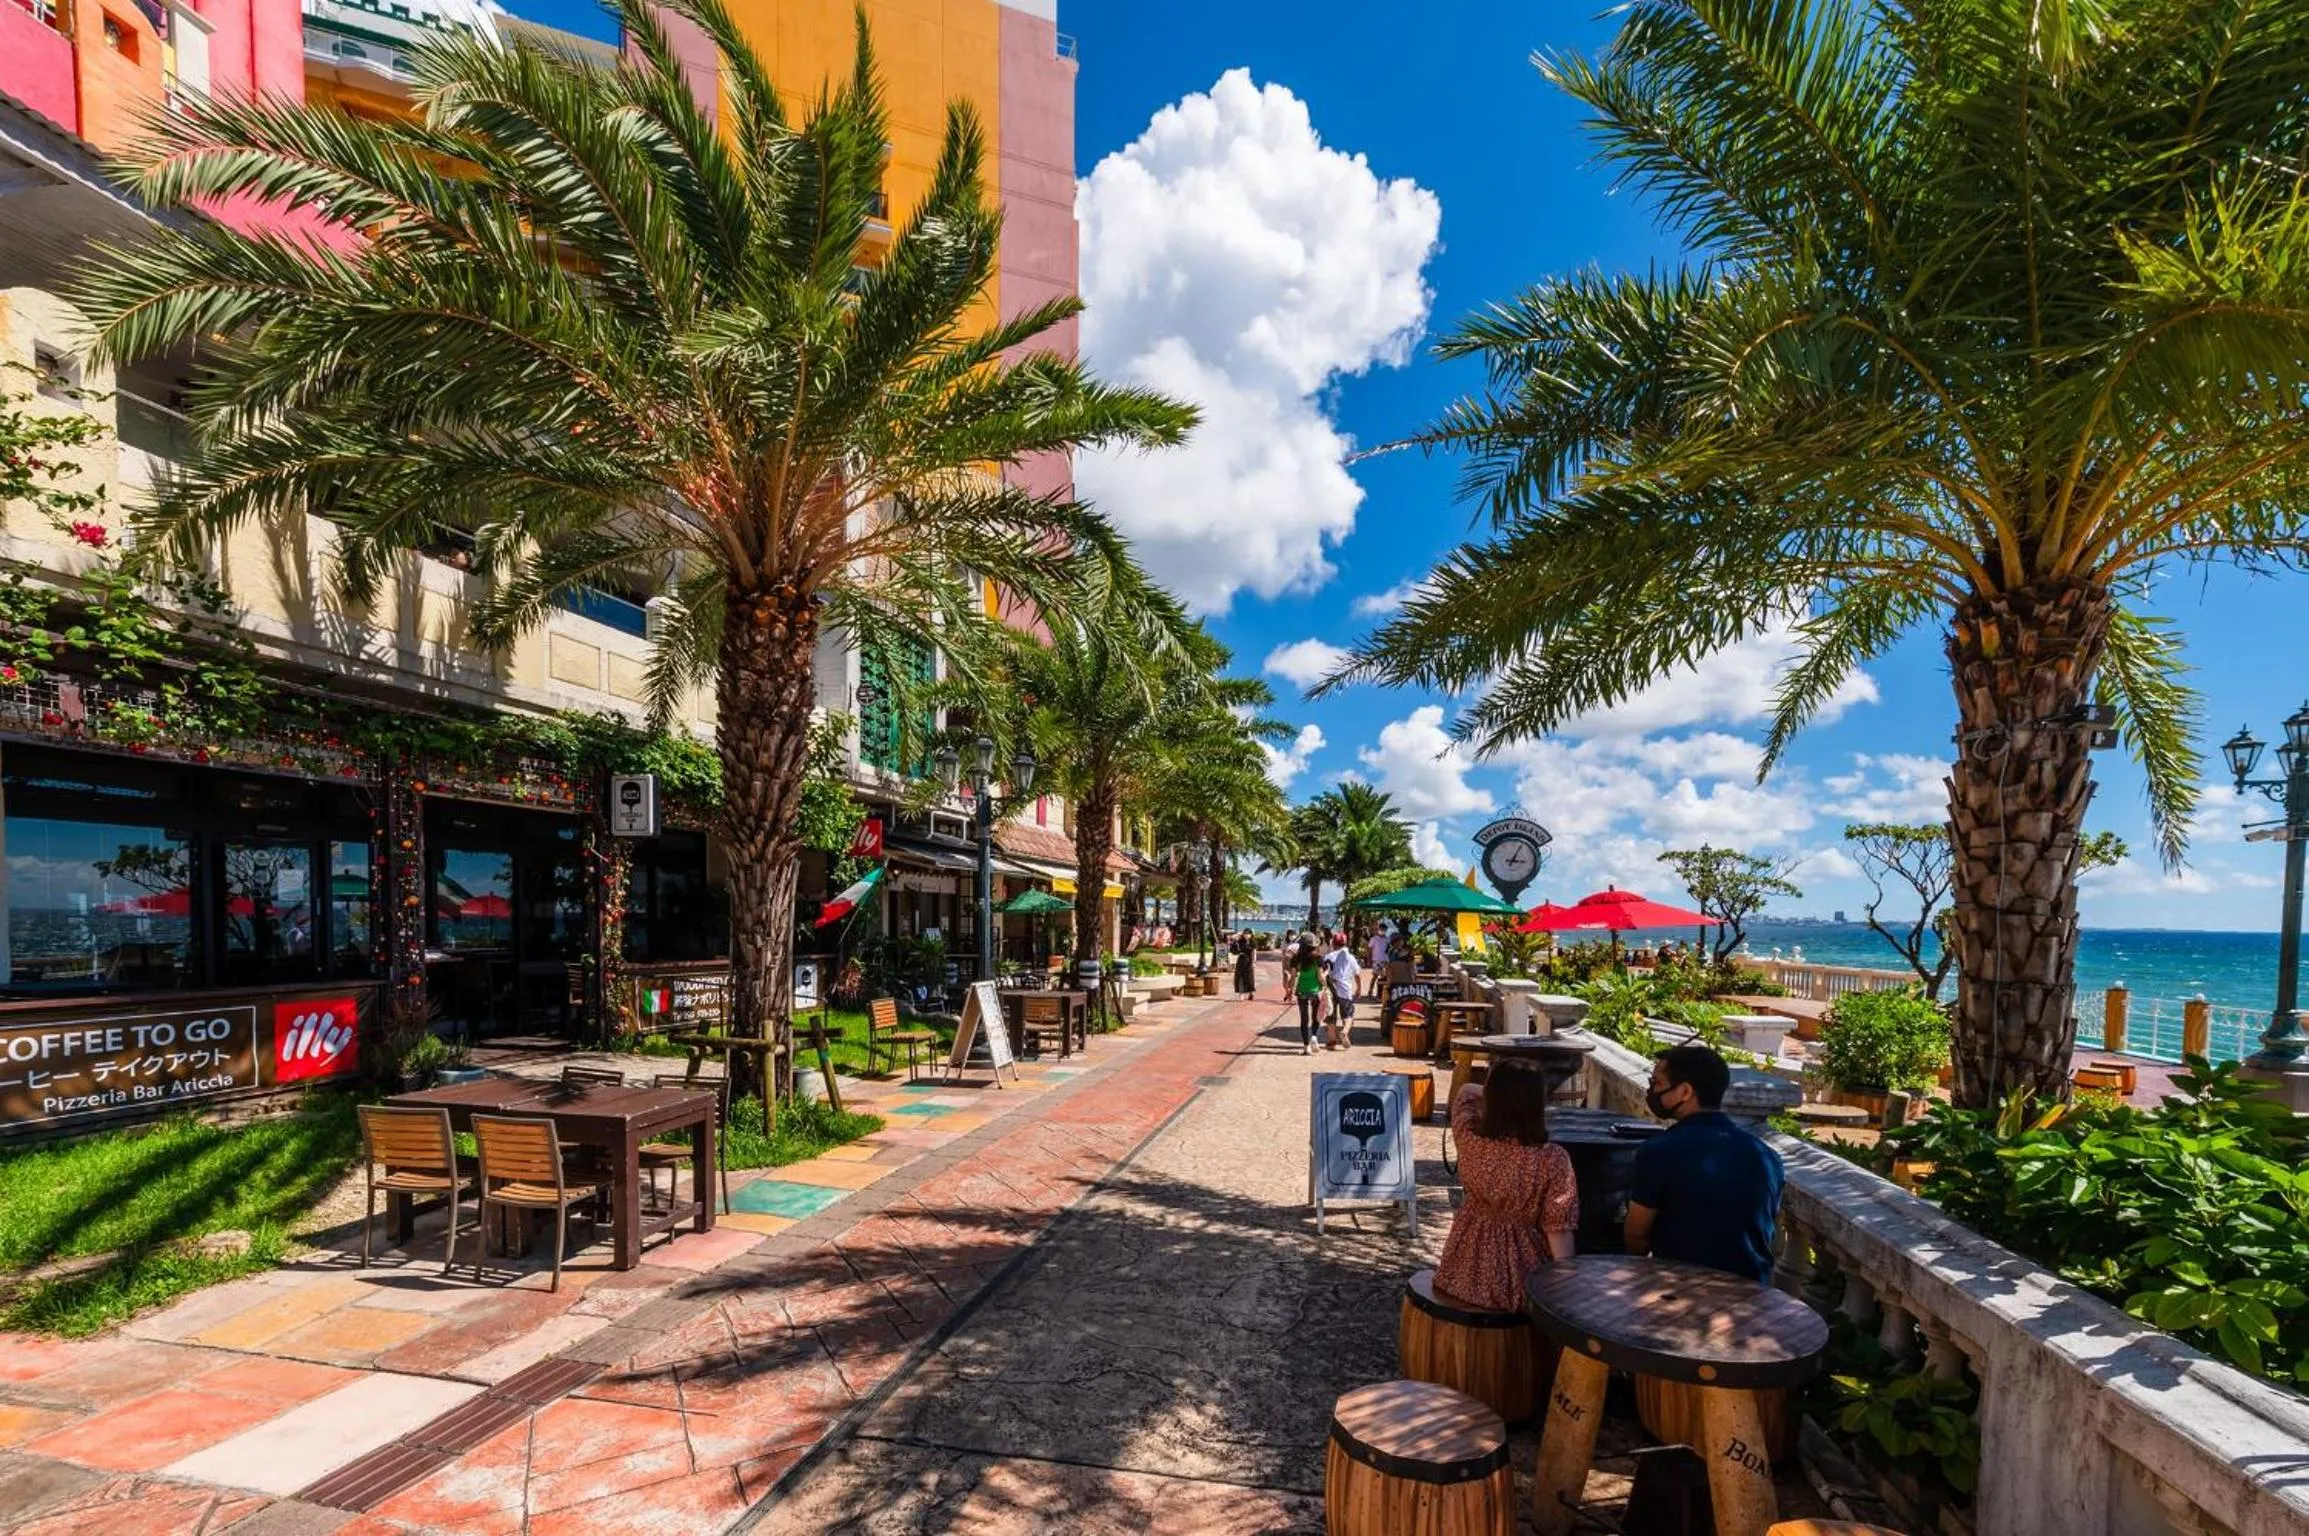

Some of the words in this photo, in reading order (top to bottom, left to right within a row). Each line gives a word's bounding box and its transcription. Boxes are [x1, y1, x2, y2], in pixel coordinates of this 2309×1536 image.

[1480, 822, 1511, 841] DEPOT
[1514, 821, 1546, 841] ISLAND
[130, 1023, 176, 1048] TO
[184, 1017, 231, 1042] GO
[282, 1012, 353, 1068] illy
[92, 1047, 231, 1082] テイクアウト
[43, 1088, 127, 1114] Pizzeria
[133, 1084, 165, 1100] Bar
[171, 1073, 234, 1095] Ariccia
[1343, 1107, 1382, 1126] ARICCIA
[1340, 1150, 1391, 1161] PIZZERIA
[1352, 1161, 1376, 1171] BAR
